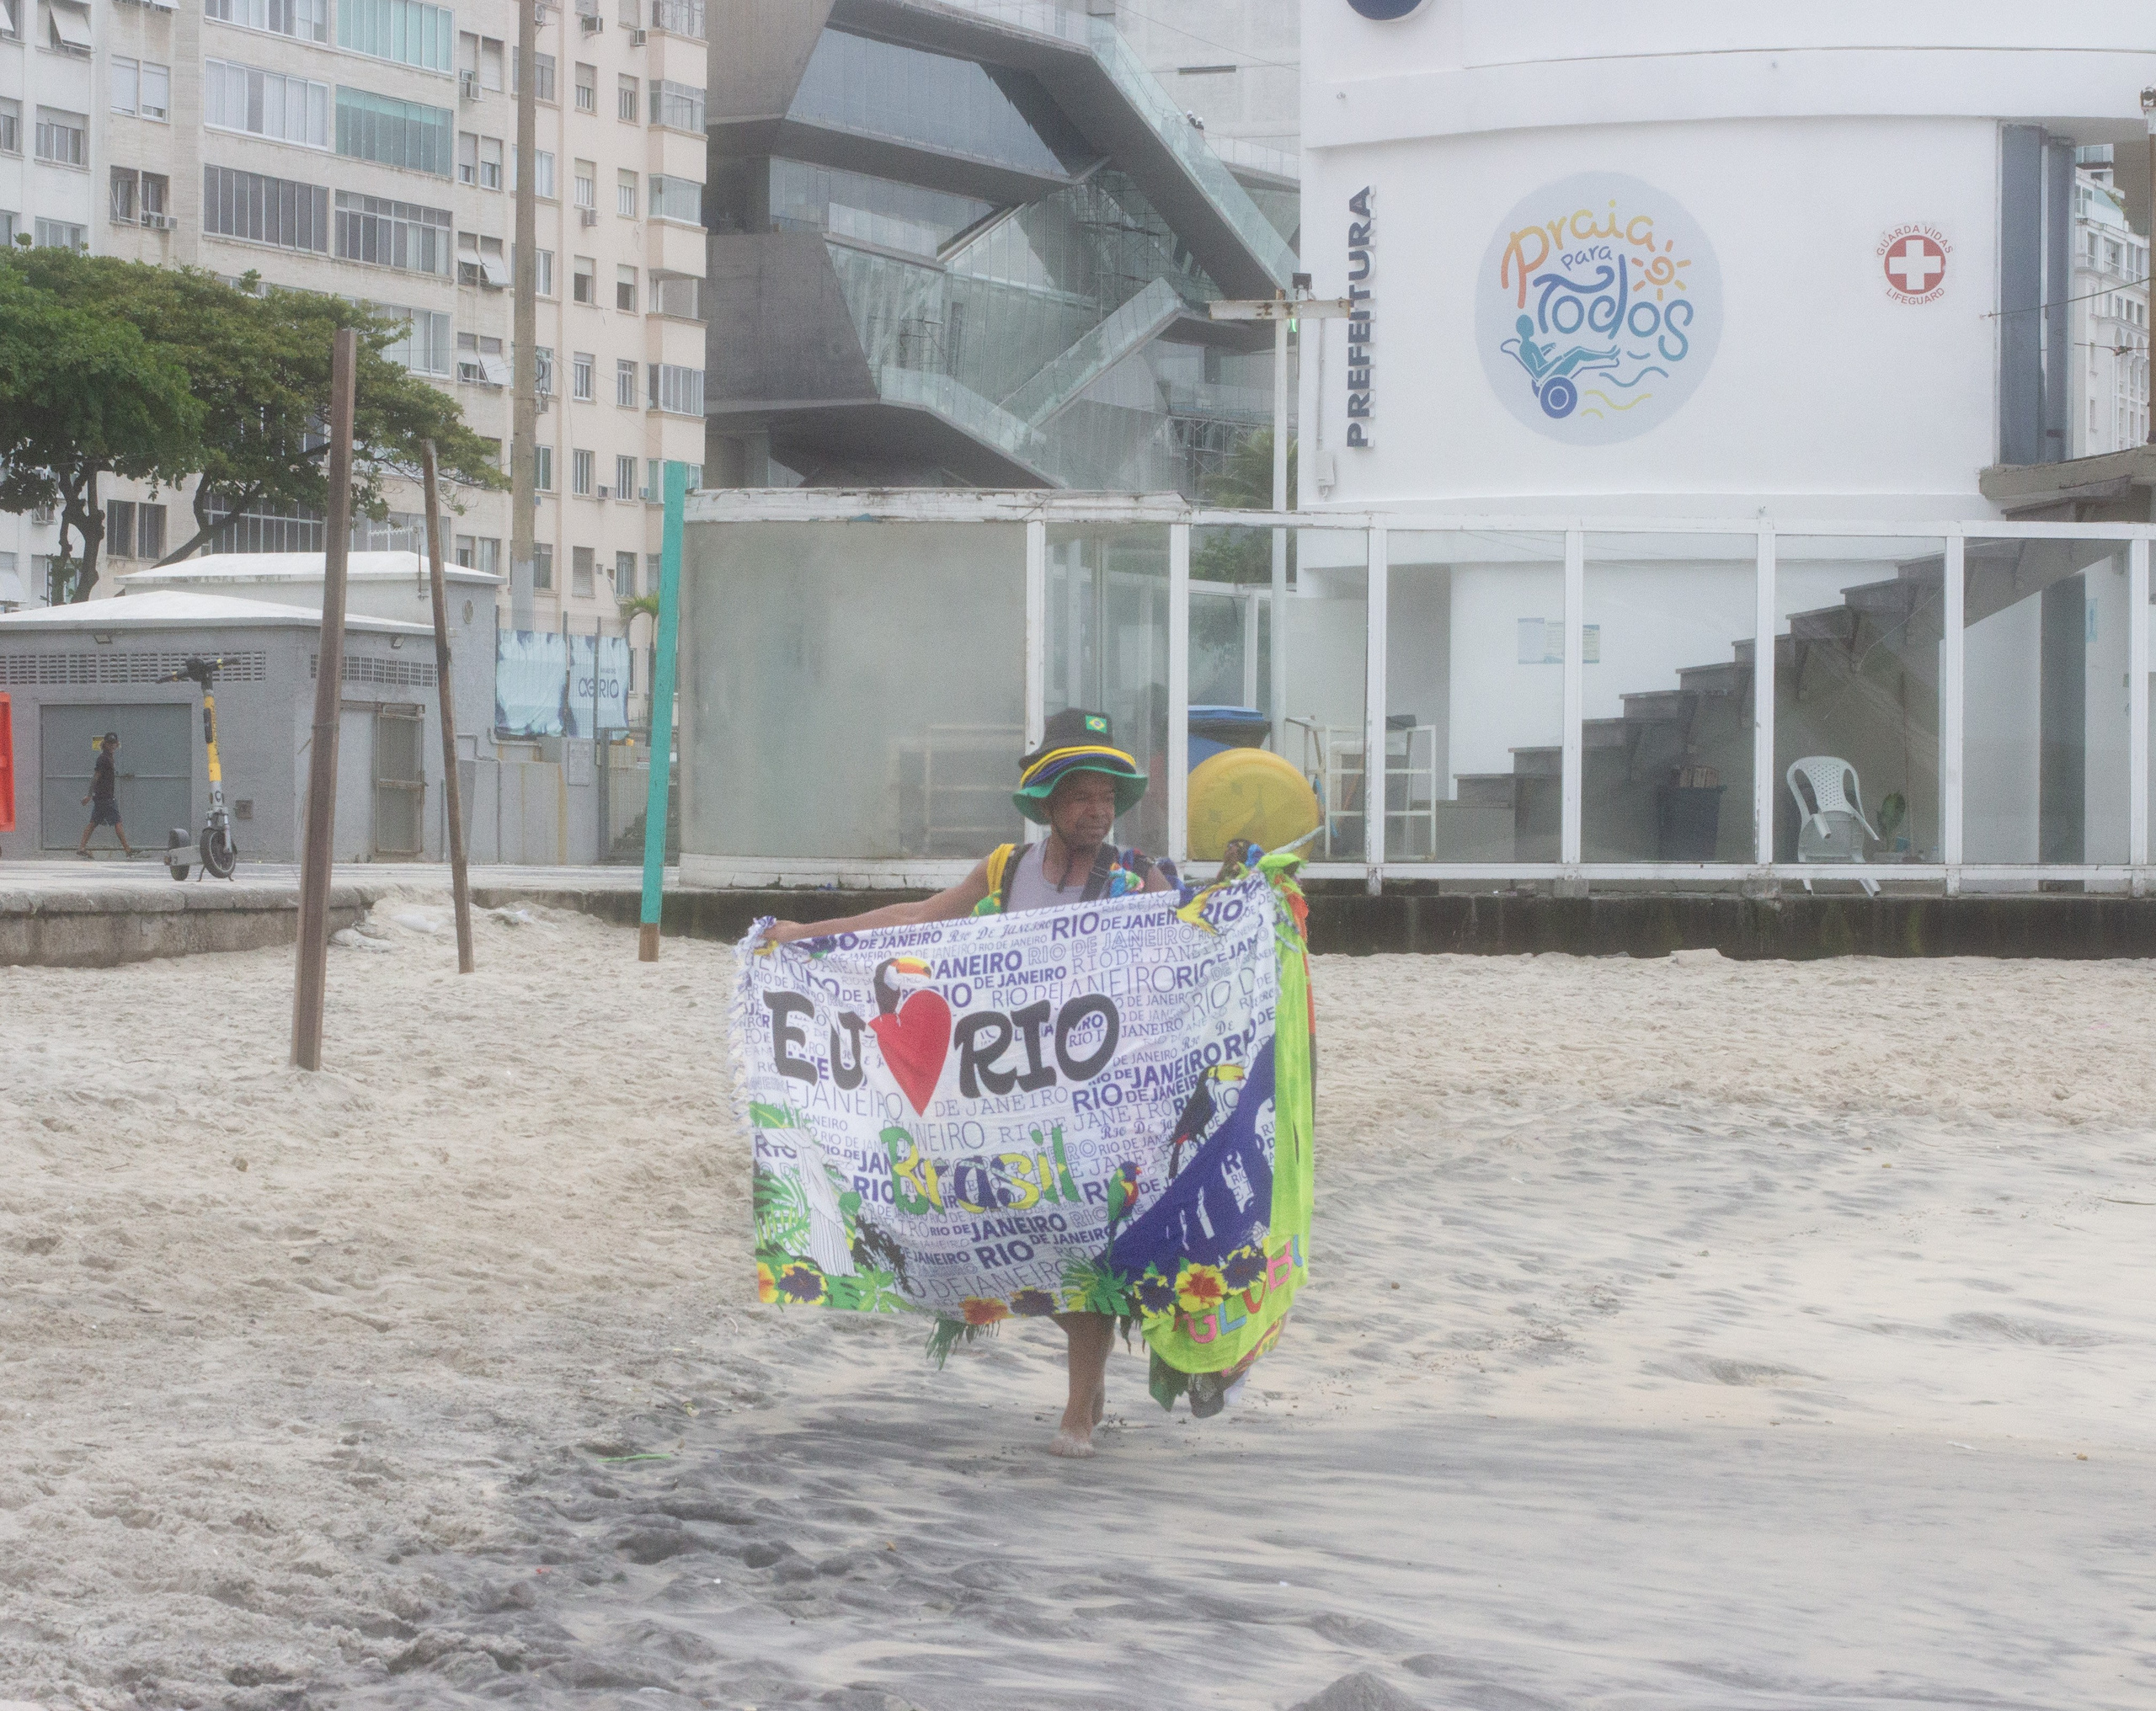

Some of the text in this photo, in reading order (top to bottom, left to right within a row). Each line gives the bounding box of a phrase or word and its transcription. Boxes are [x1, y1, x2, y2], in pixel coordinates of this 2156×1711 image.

[1876, 225, 1953, 256] GUARDA VIDAS
[1501, 199, 1656, 309] Praia
[1560, 245, 1613, 271] para
[1886, 287, 1945, 305] LIFEGUARD
[1347, 185, 1374, 447] PREFEITURA
[1052, 912, 1100, 941] RIO
[1101, 916, 1122, 931] DE
[1123, 908, 1182, 930] JANEIR
[859, 939, 878, 951] DE
[878, 930, 942, 949] JANEIRO
[979, 941, 995, 952] RIO
[995, 941, 1008, 951] DE
[1010, 934, 1048, 947] JANEIRO
[1027, 943, 1066, 966] RIO
[1071, 935, 1097, 958] DE
[1102, 925, 1194, 951] JANEIRO
[1072, 950, 1113, 974] RIO
[754, 970, 772, 984] RIO
[775, 975, 789, 989] DE
[974, 966, 1067, 989] DE JANEIRO
[842, 989, 862, 1003] DE
[992, 987, 1027, 1009] RIO
[1127, 996, 1143, 1008] DE
[1121, 1017, 1184, 1038] JANEIRO
[1129, 1010, 1145, 1022] DE
[763, 990, 1119, 1098] EU RIO
[1113, 1047, 1177, 1068] DE JANEIRO
[1114, 1069, 1133, 1079] DE
[1130, 1042, 1222, 1089] JANEIRO
[934, 1086, 1068, 1117] DE JANEIRO
[1072, 1074, 1198, 1113] RIO DE JANEIR
[1074, 1100, 1171, 1132] JANEIRO
[820, 1131, 841, 1145] RIO
[845, 1136, 858, 1149] DE
[1098, 1141, 1120, 1156] RIO
[1122, 1137, 1139, 1151] DE
[844, 1149, 861, 1160] DE
[1139, 1178, 1161, 1195] DE
[930, 1226, 950, 1237] RIO
[953, 1224, 971, 1235] DE
[970, 1213, 1067, 1242] JANEIRO
[912, 1251, 971, 1266] JANEIRO
[974, 1240, 1034, 1270] RIO
[1029, 1234, 1050, 1245] DE
